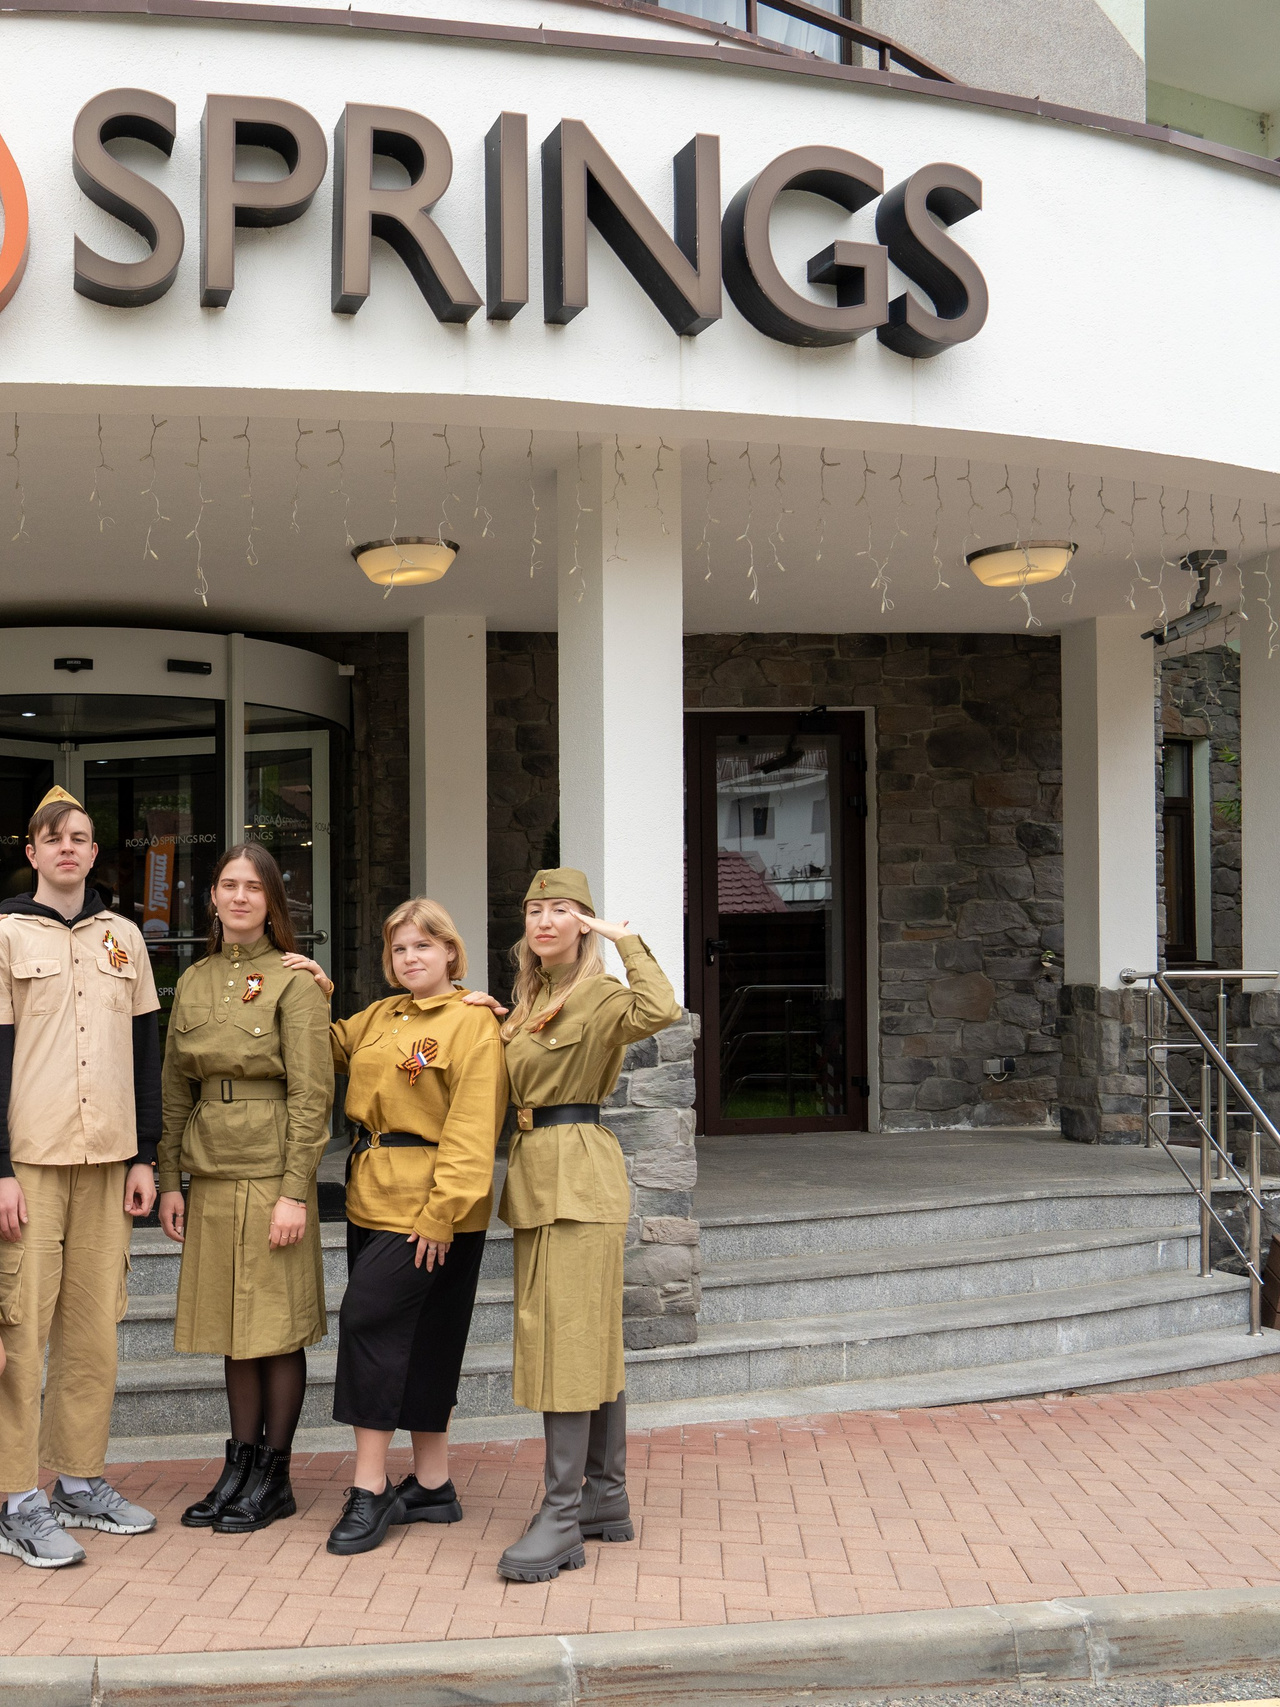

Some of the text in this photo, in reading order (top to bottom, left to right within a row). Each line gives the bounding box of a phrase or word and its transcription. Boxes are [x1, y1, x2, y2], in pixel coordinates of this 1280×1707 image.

[72, 88, 990, 359] SPRINGS
[253, 814, 275, 825] ROSA
[125, 838, 150, 848] ROSA
[161, 834, 198, 845] SPRINGS
[149, 850, 169, 911] Груша
